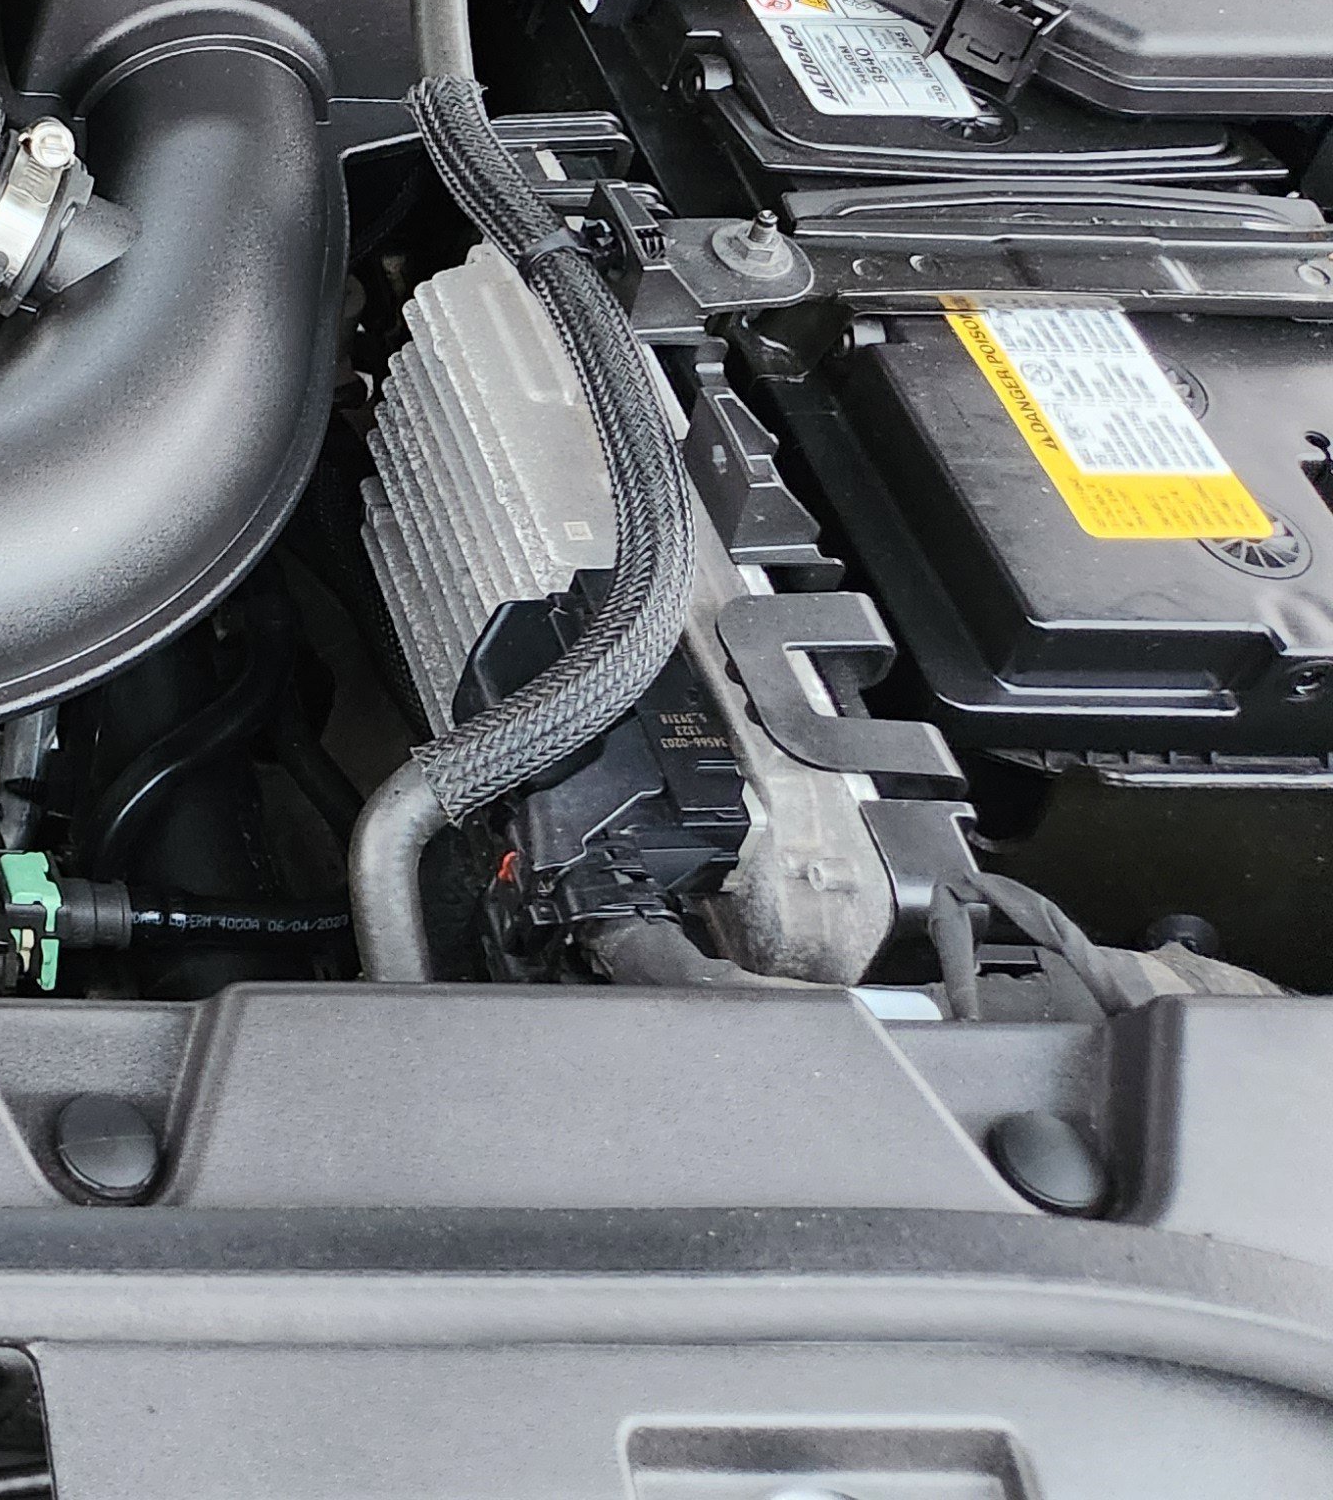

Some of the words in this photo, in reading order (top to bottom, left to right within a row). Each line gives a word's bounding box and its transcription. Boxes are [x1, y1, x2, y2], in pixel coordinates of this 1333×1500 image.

[780, 24, 840, 103] ACDelco
[838, 45, 870, 86] 94RAGM
[855, 47, 888, 84] 8540
